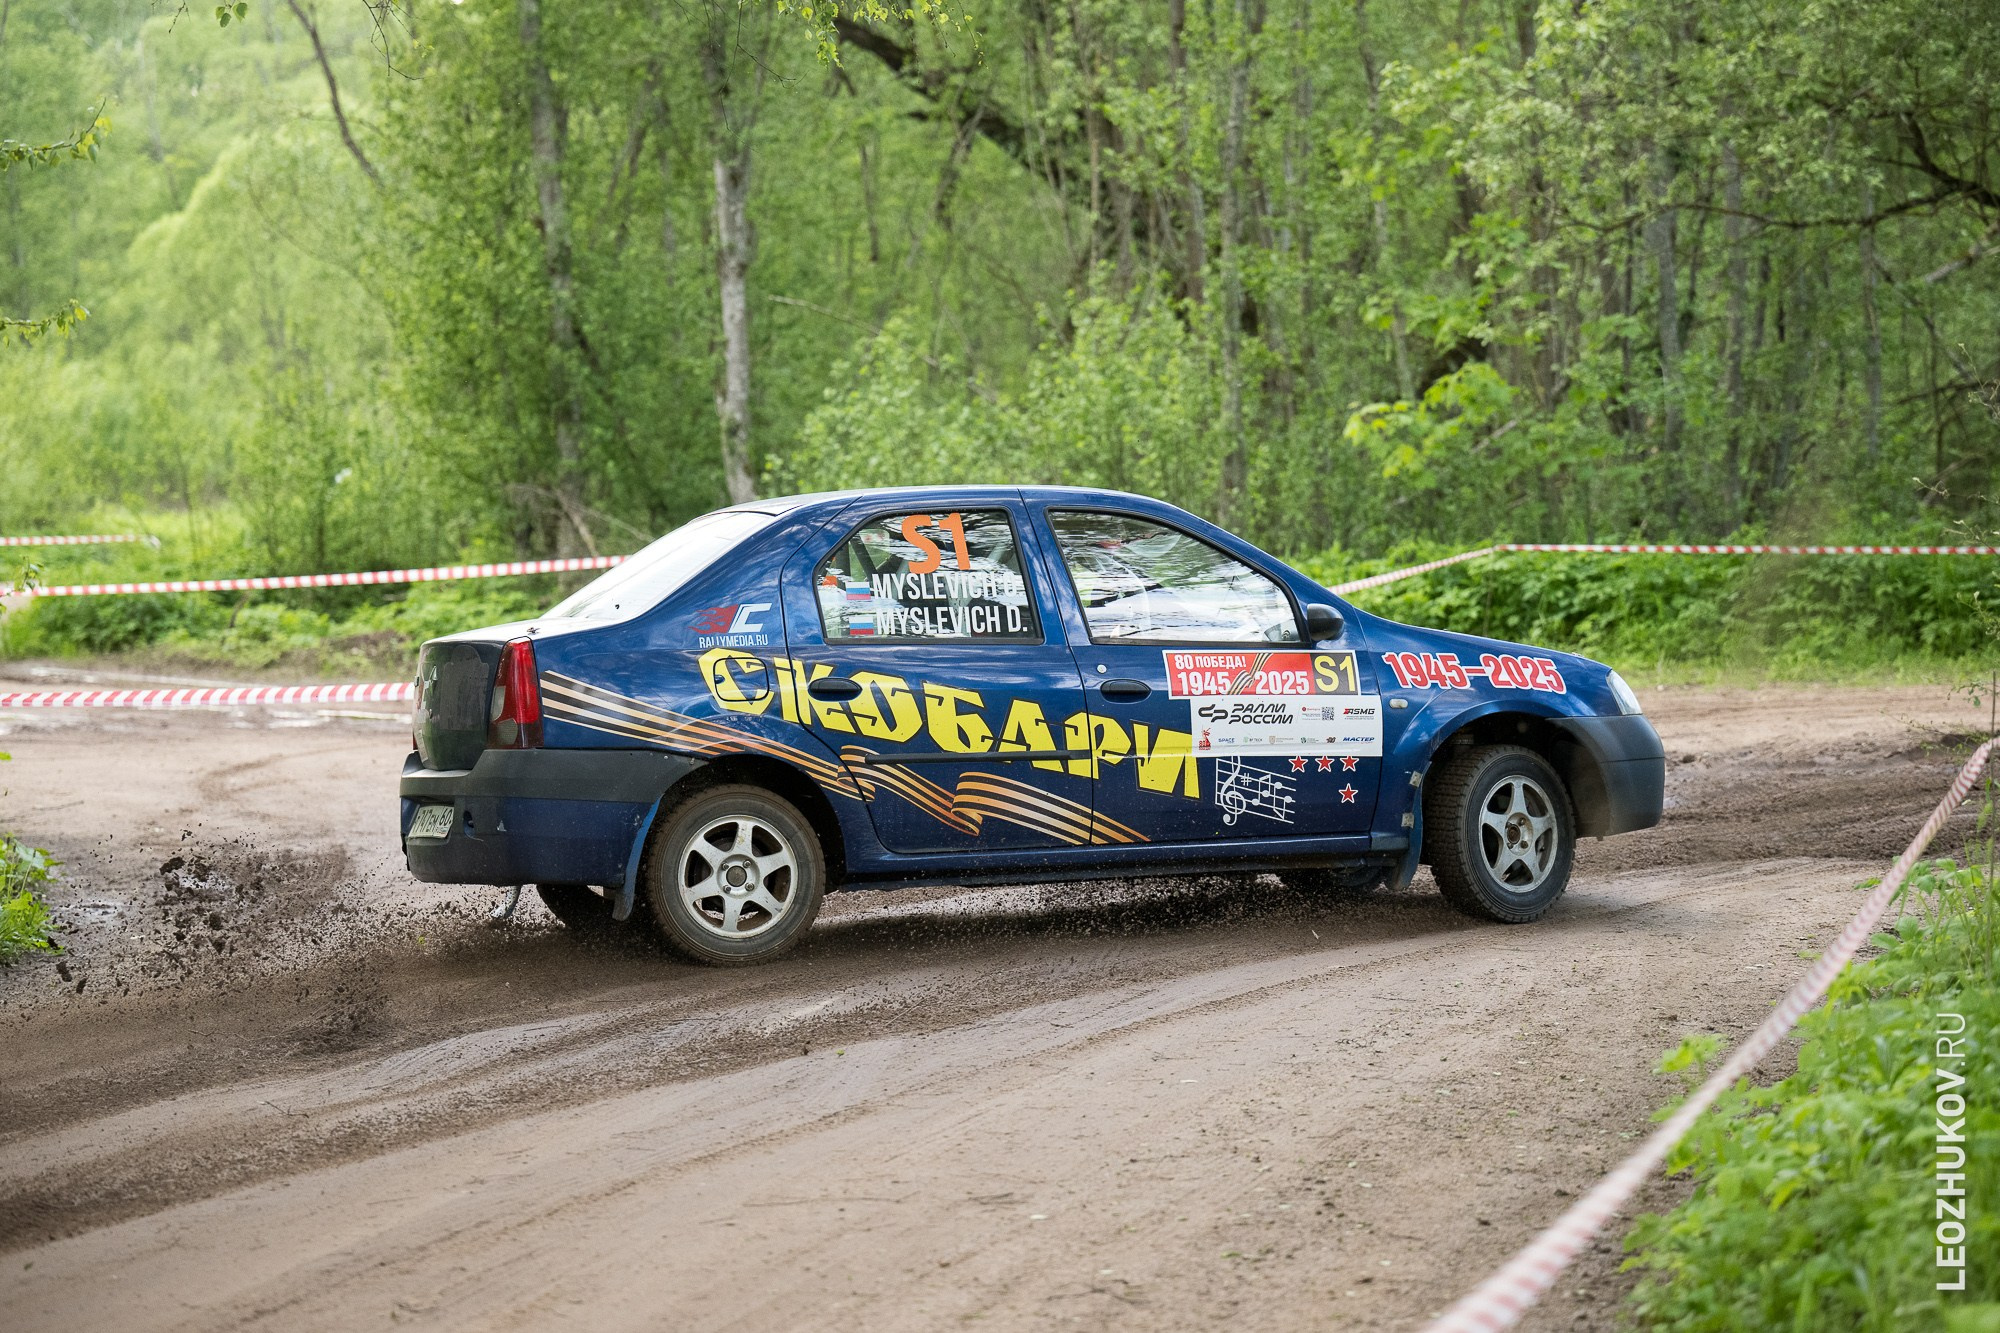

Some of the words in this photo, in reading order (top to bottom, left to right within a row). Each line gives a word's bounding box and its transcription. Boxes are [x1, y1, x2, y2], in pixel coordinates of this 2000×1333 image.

[902, 512, 971, 574] S1
[871, 571, 996, 600] MYSLEVICH
[875, 605, 1001, 635] MYSLEVICH
[1007, 605, 1028, 633] D.
[698, 634, 769, 649] RALLYMEDIA.RU
[1174, 654, 1194, 670] 80
[1195, 655, 1247, 669] ПОБЕДА!
[1314, 655, 1357, 692] S1
[1177, 671, 1232, 695] 1945
[1254, 670, 1310, 695] 2025
[1228, 714, 1294, 725] РОССИИ
[1231, 703, 1287, 714] РАЛЛИ
